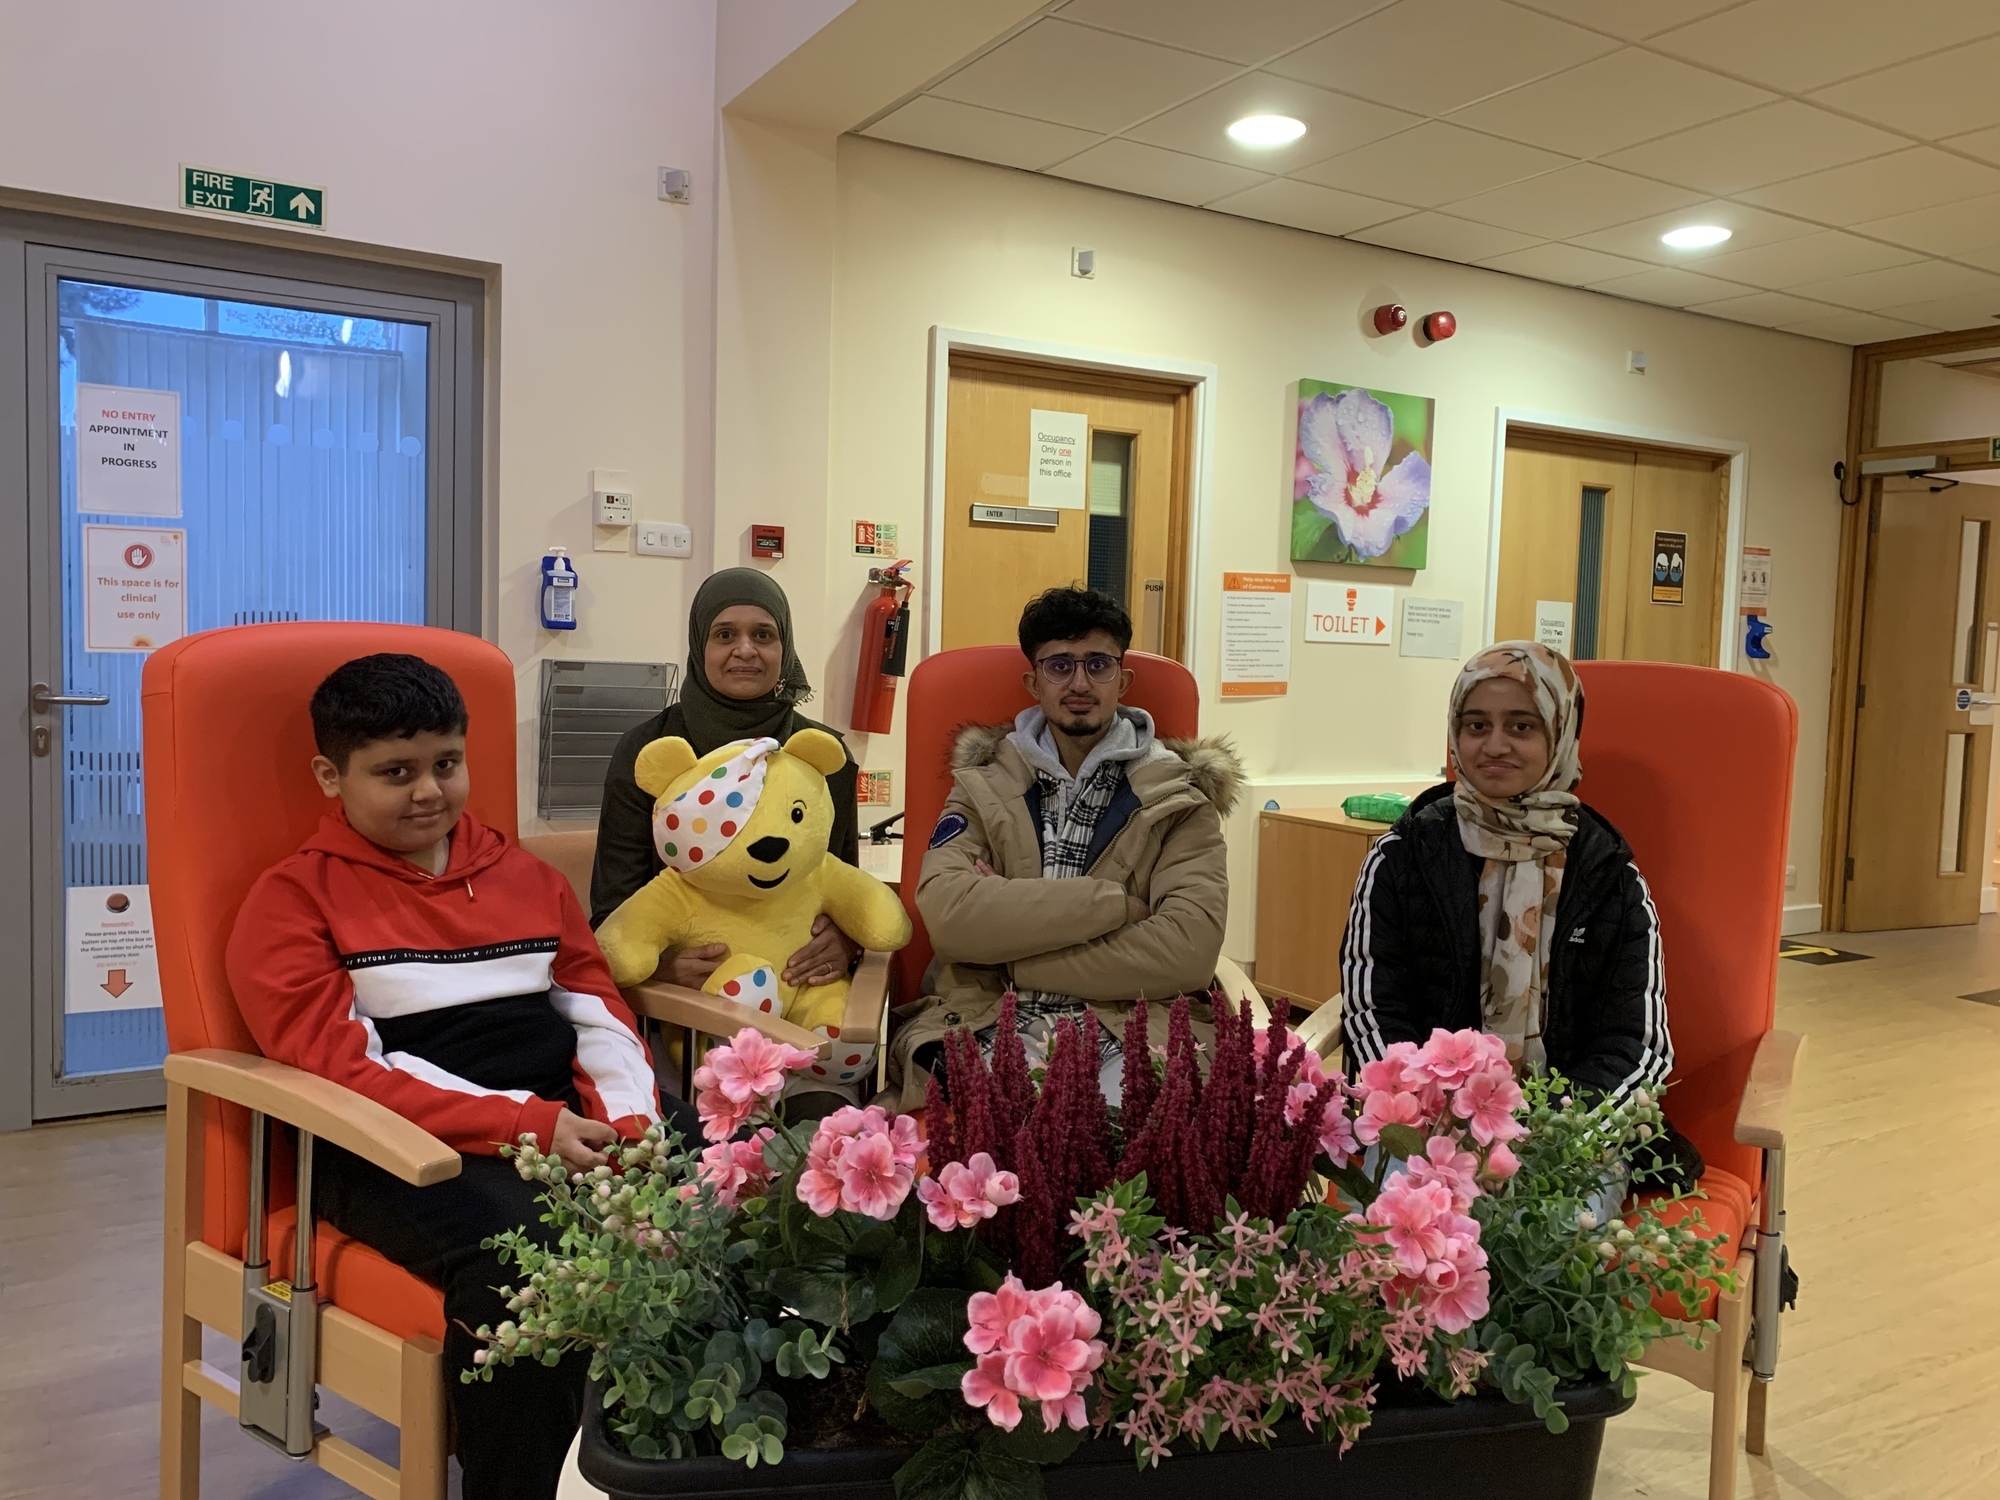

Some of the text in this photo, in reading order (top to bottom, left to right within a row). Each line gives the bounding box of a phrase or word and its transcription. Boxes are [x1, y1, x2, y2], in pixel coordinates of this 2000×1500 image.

[192, 171, 234, 191] FIRE
[192, 190, 234, 209] EXIT
[102, 410, 156, 421] NO ENTRY
[89, 424, 168, 438] APPOINTMENT
[1037, 432, 1076, 445] Occupancy
[123, 443, 135, 451] IN
[1041, 445, 1072, 457] Only one
[101, 457, 157, 469] PROGRESS
[1039, 468, 1072, 478] this office
[986, 510, 1003, 518] ENTER
[97, 577, 179, 588] This space is for
[1145, 584, 1163, 592] PUSH
[121, 593, 157, 603] clinical
[117, 611, 161, 621] use only
[1313, 614, 1370, 634] TOILET
[1542, 628, 1553, 636] Only
[357, 955, 386, 963] FUTURE
[496, 945, 522, 953] FUTURE
